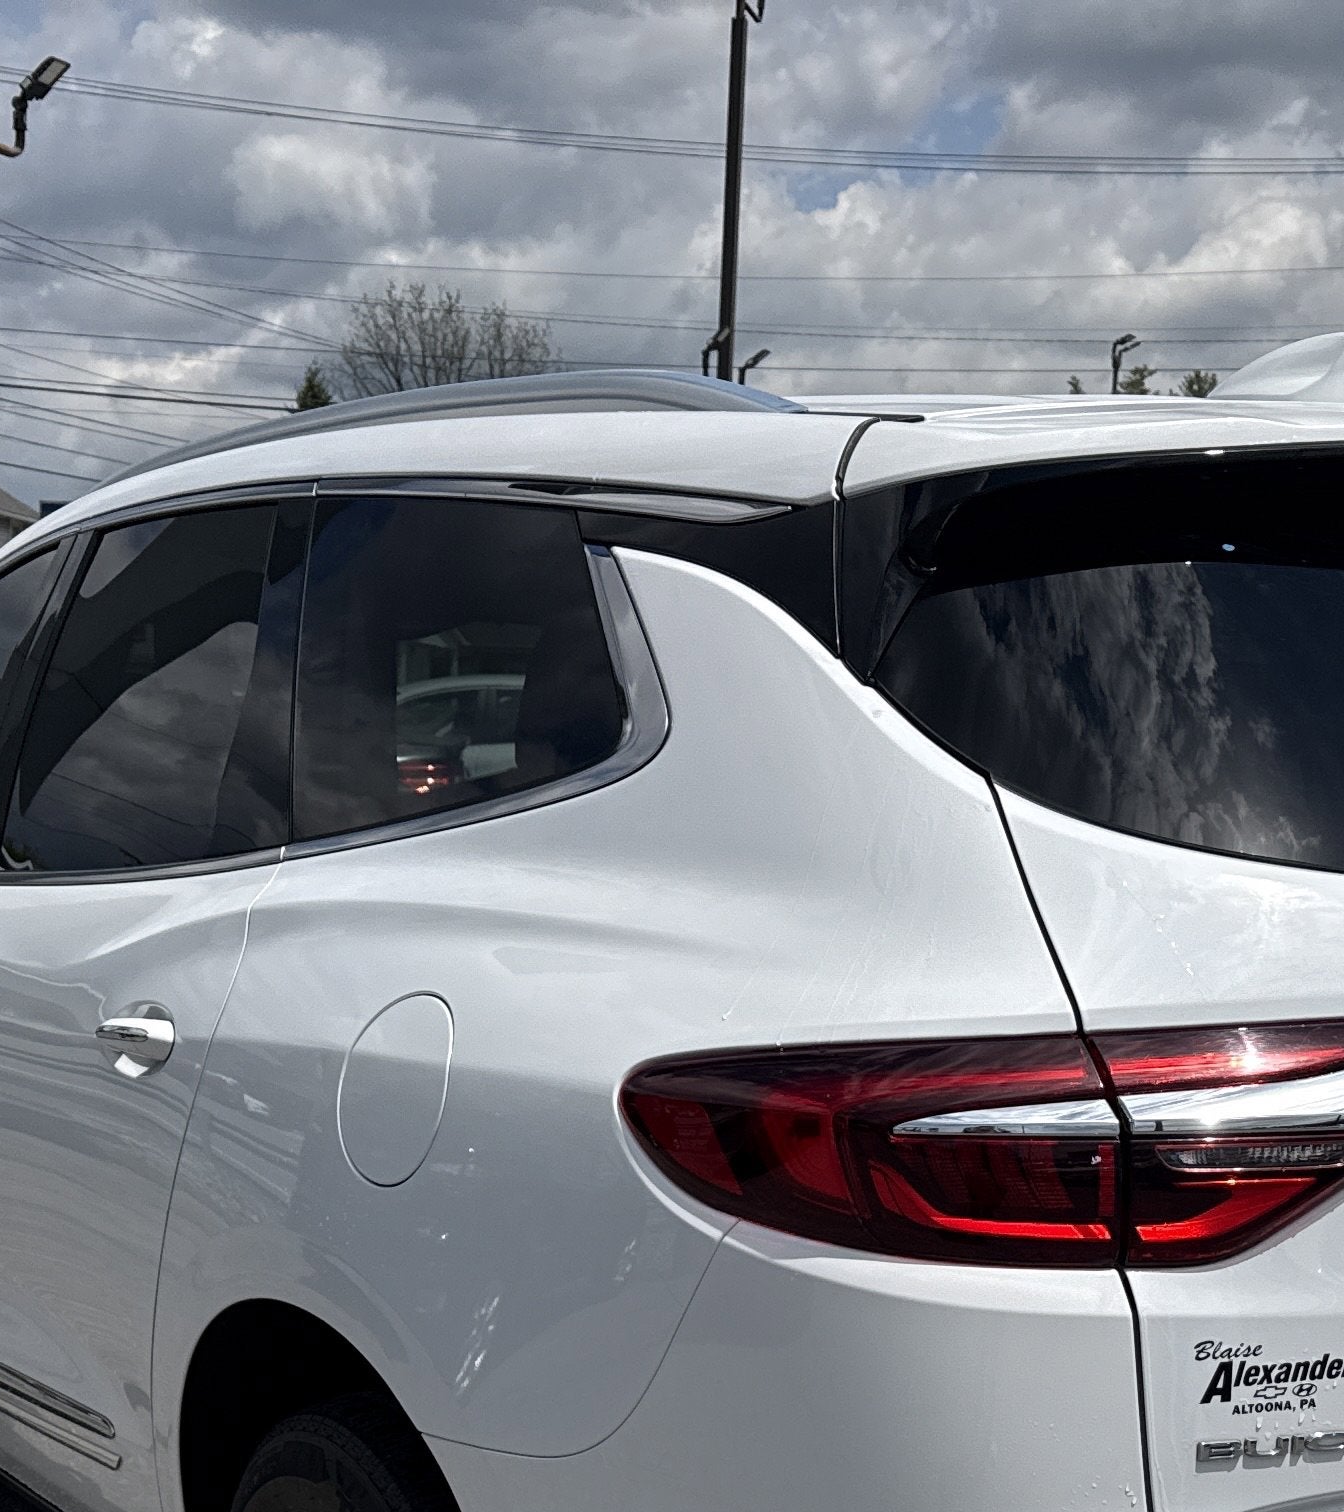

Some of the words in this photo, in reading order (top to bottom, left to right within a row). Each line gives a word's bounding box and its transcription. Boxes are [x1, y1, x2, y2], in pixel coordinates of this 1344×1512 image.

[1194, 1340, 1263, 1361] Blaise
[1232, 1400, 1297, 1415] ALTOONA,
[1300, 1398, 1317, 1410] PA
